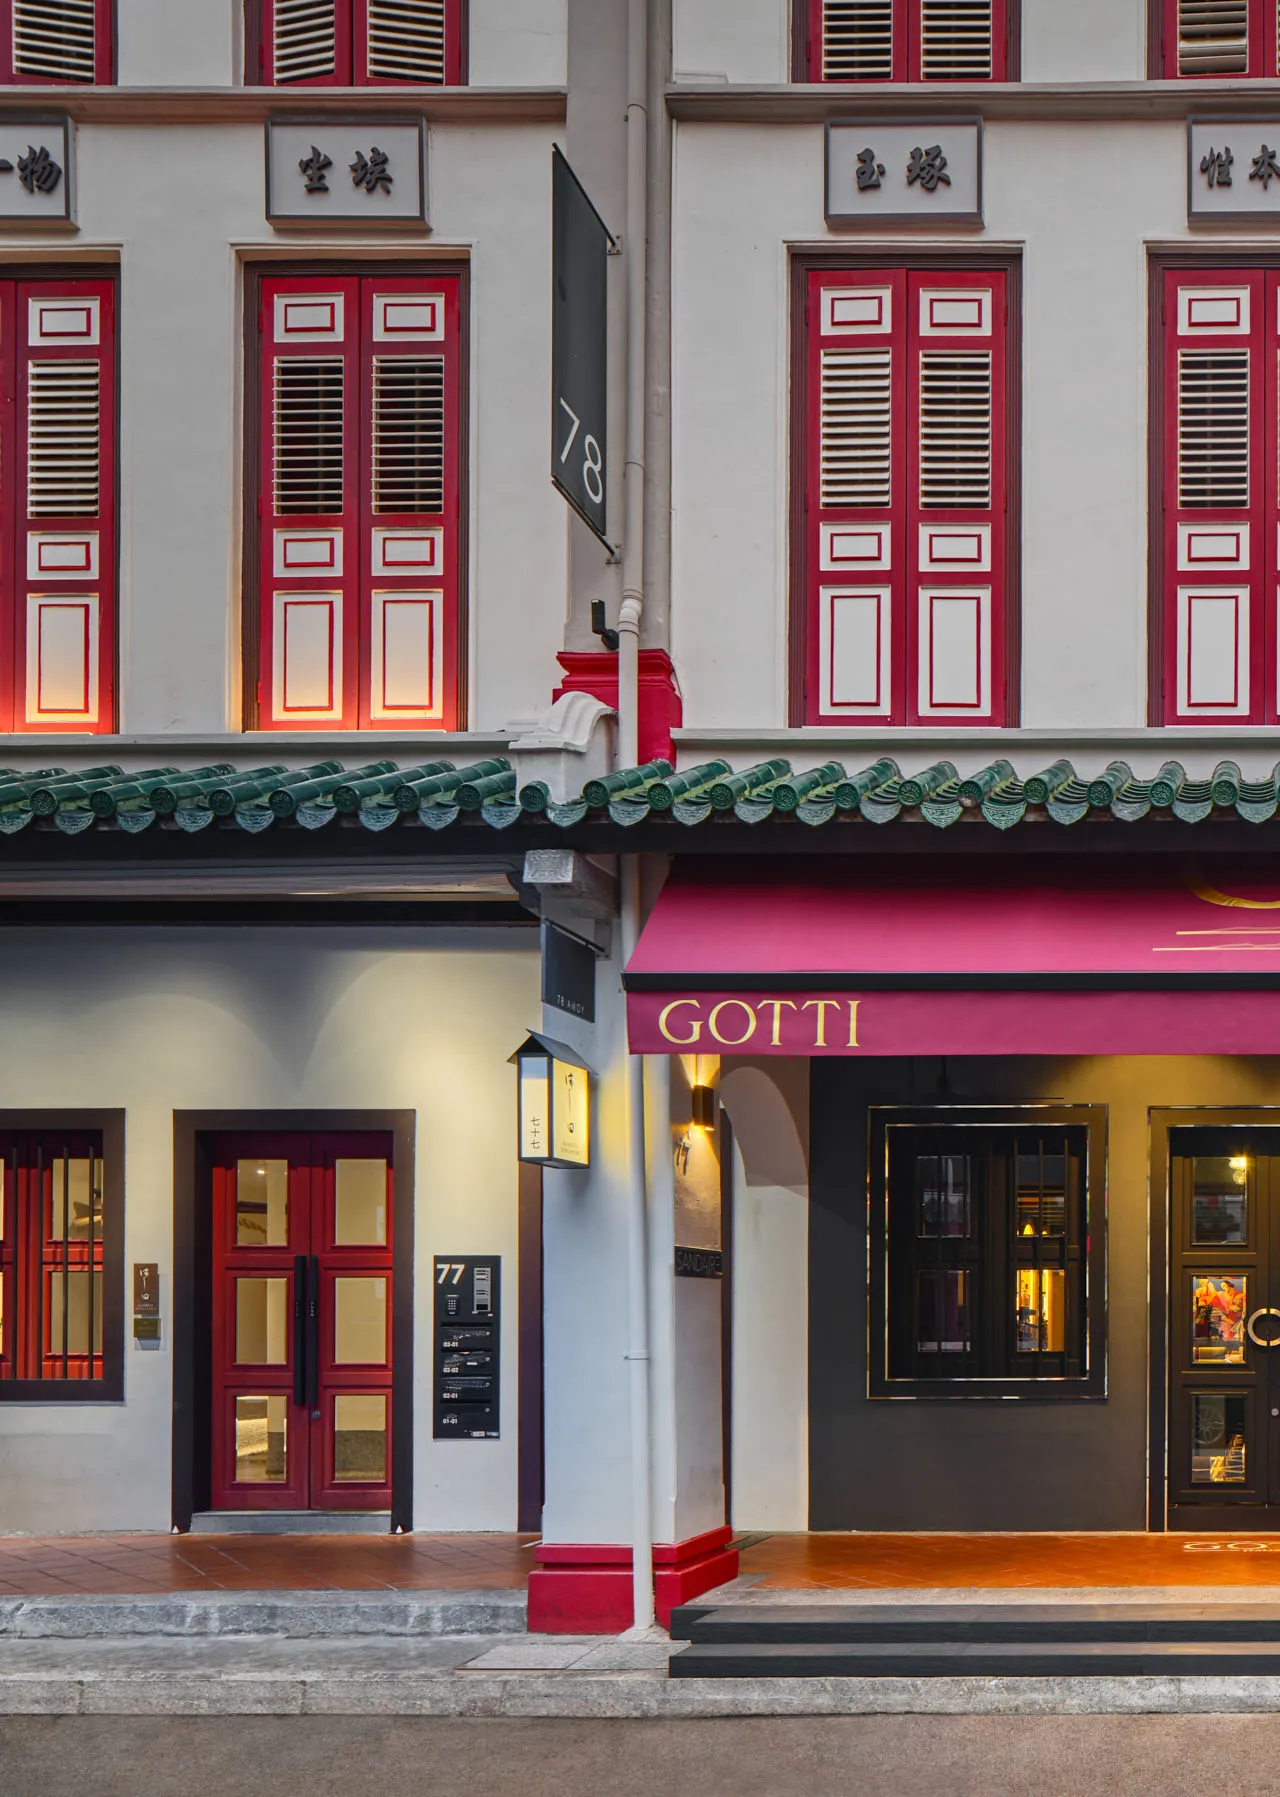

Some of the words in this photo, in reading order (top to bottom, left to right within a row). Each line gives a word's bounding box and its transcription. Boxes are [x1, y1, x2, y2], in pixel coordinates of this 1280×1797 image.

[560, 397, 602, 503] 78
[658, 999, 860, 1047] GOTTI
[436, 1264, 465, 1284] 77
